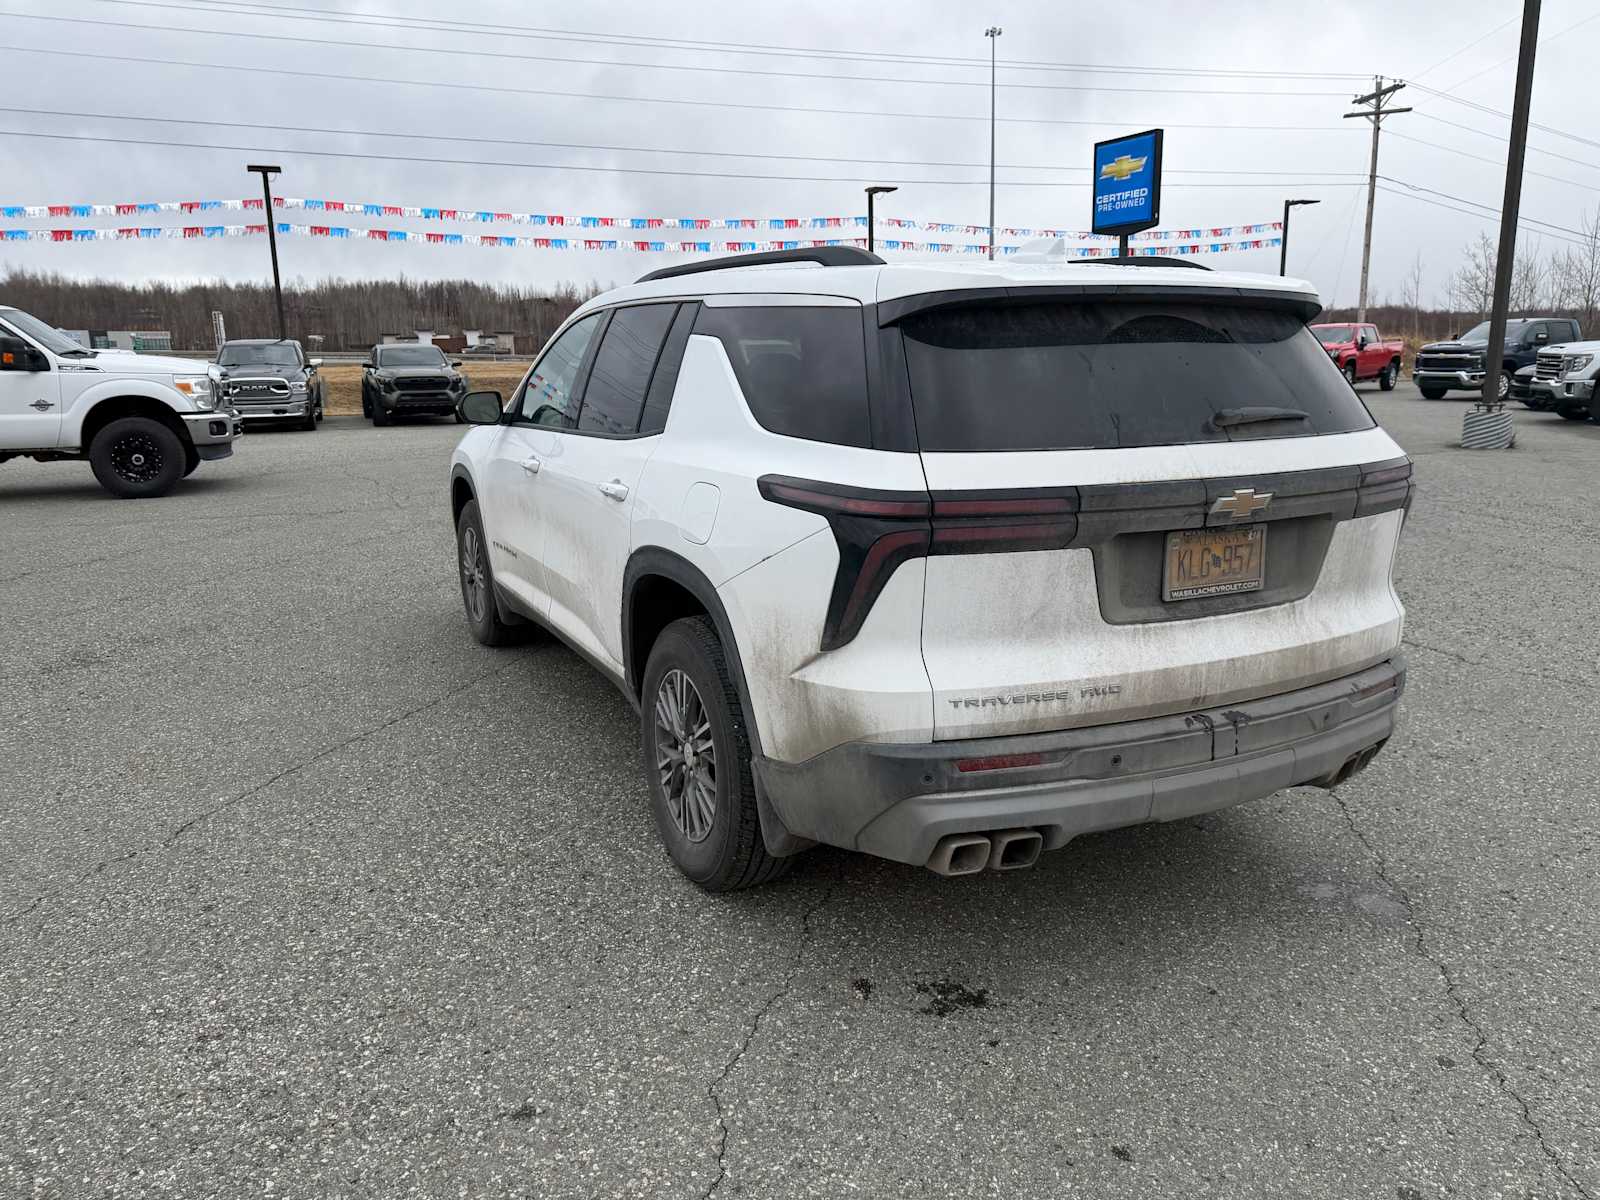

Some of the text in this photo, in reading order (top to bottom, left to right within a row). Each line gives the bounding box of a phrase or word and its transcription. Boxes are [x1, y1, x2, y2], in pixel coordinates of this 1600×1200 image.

[1096, 188, 1148, 204] CERTIFIED
[1097, 198, 1145, 212] PRE-OWNED
[1177, 547, 1211, 582] KLG
[1171, 581, 1259, 598] WASILLACHEVROLET.COM
[948, 690, 1069, 709] TRAVERSE
